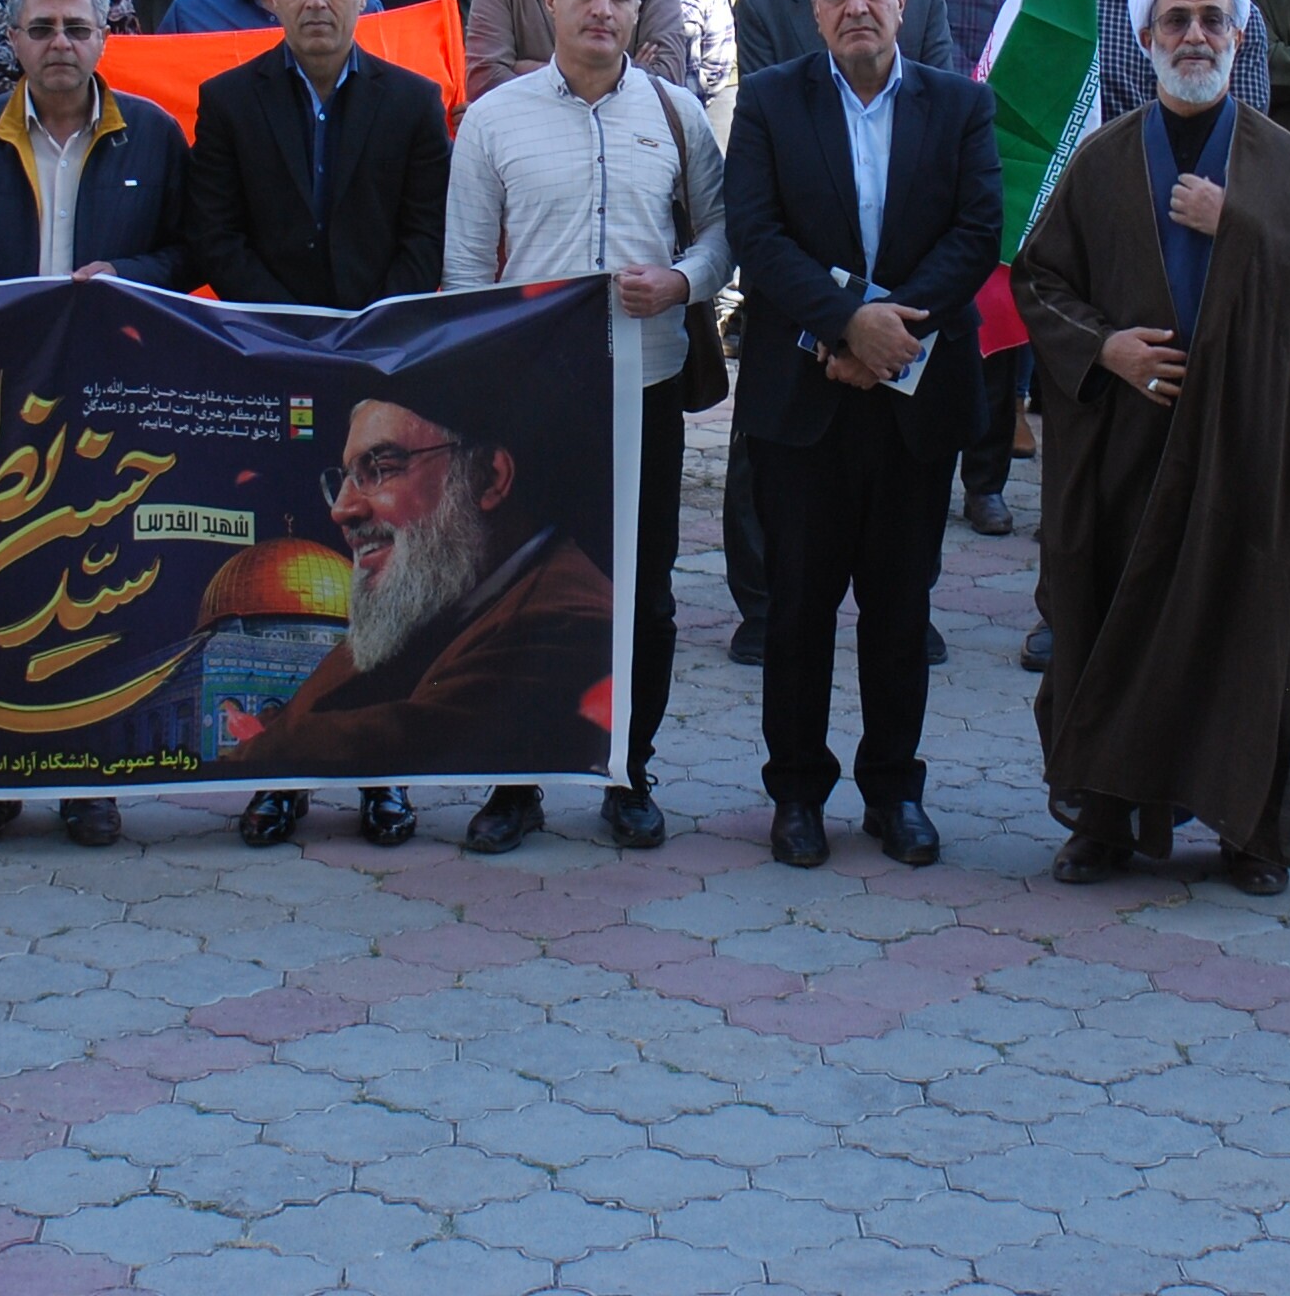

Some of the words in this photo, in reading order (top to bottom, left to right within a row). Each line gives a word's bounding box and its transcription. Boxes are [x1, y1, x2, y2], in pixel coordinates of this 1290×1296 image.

[83, 385, 93, 397] به
[94, 382, 101, 397] را
[152, 387, 178, 398] حسن
[128, 402, 136, 414] و
[137, 400, 172, 414] اسلامی
[245, 394, 281, 409] شهادت
[258, 410, 281, 424] مقام
[174, 424, 189, 433] می
[190, 423, 216, 436] عرض
[216, 424, 249, 437] تسلیت
[251, 428, 268, 441] حق
[269, 426, 281, 442] راه
[136, 510, 198, 532] القدس
[202, 514, 249, 538] شهید
[11, 751, 37, 776] آزاد
[40, 752, 100, 770] دانشگاه
[102, 753, 155, 775] عمومی
[159, 749, 198, 770] روابط
